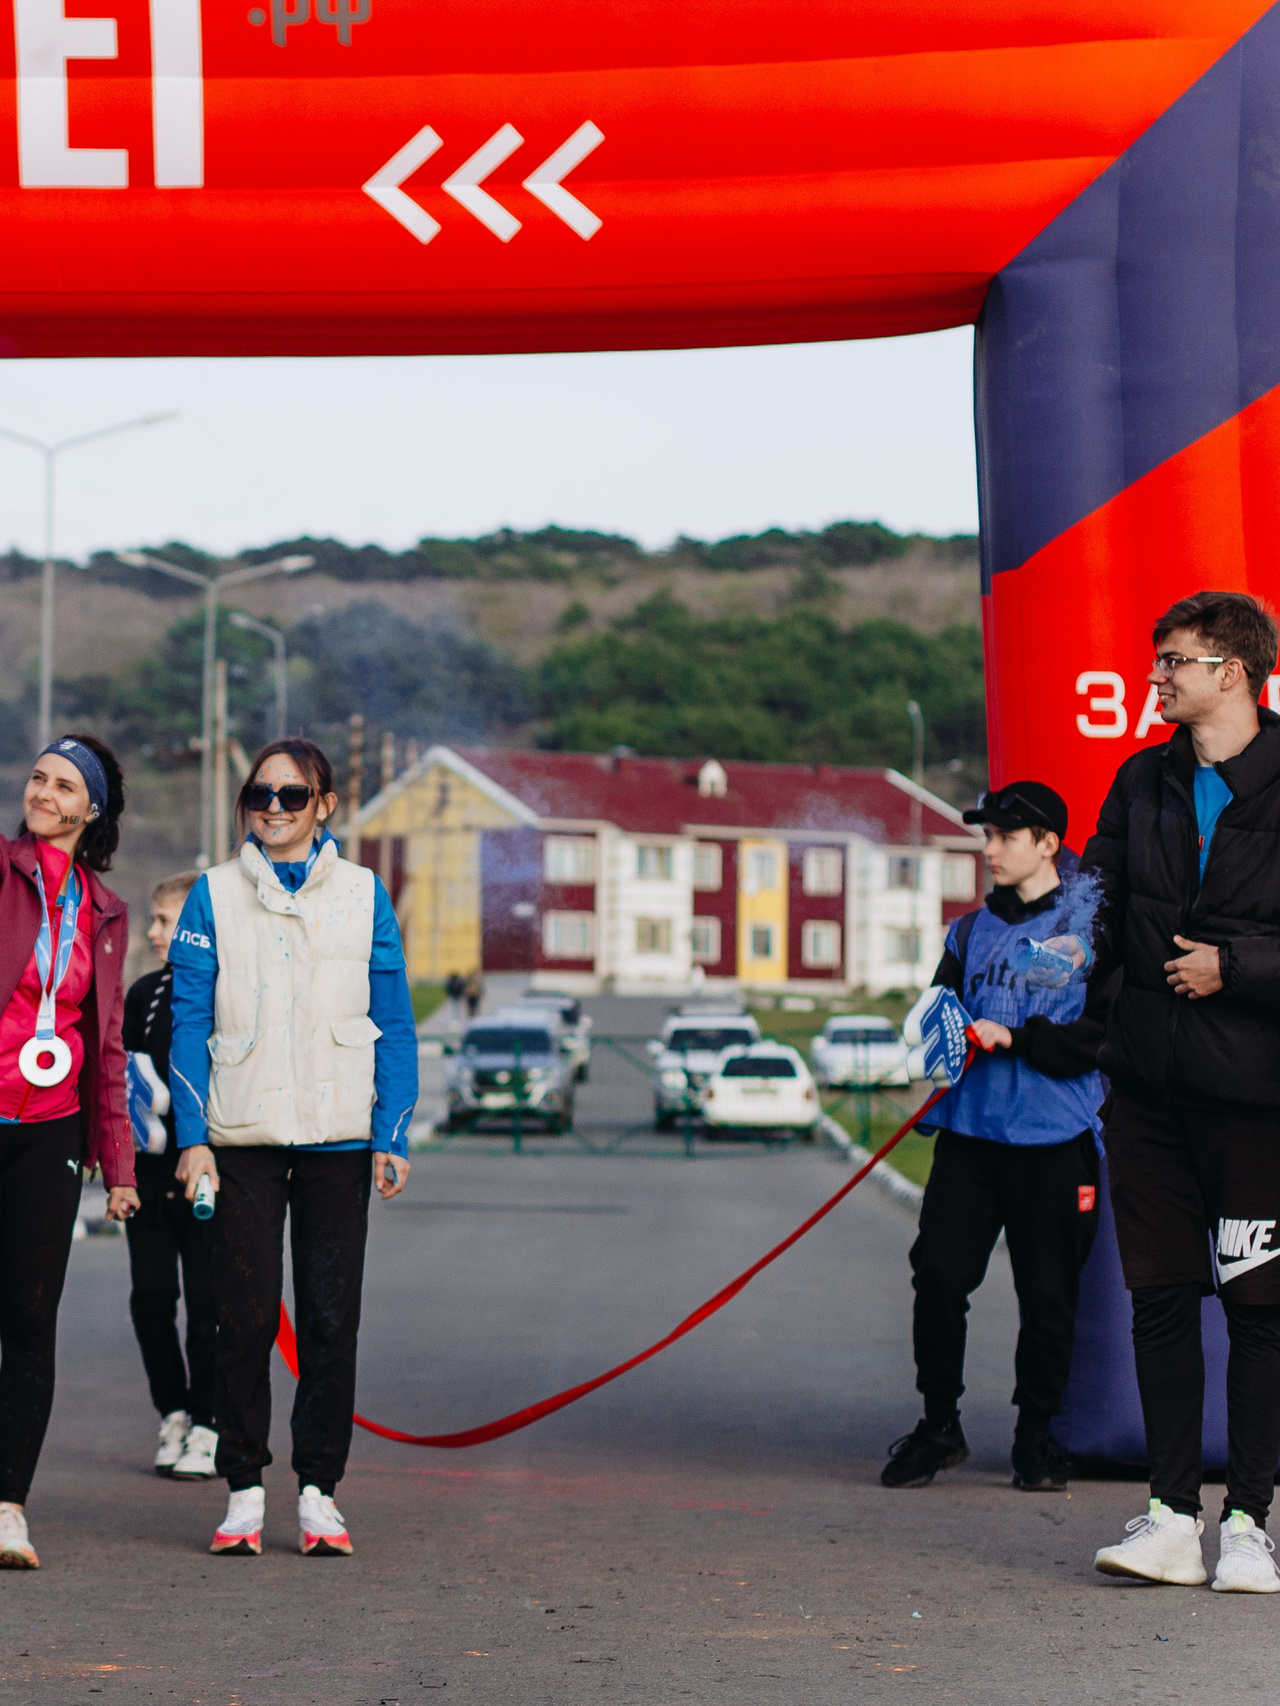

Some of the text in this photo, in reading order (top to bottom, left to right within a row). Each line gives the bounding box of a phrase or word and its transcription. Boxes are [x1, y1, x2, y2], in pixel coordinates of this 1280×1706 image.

[180, 929, 211, 949] ПСБ
[941, 1010, 956, 1067] СТРАНА
[1218, 1217, 1277, 1258] NIKE
